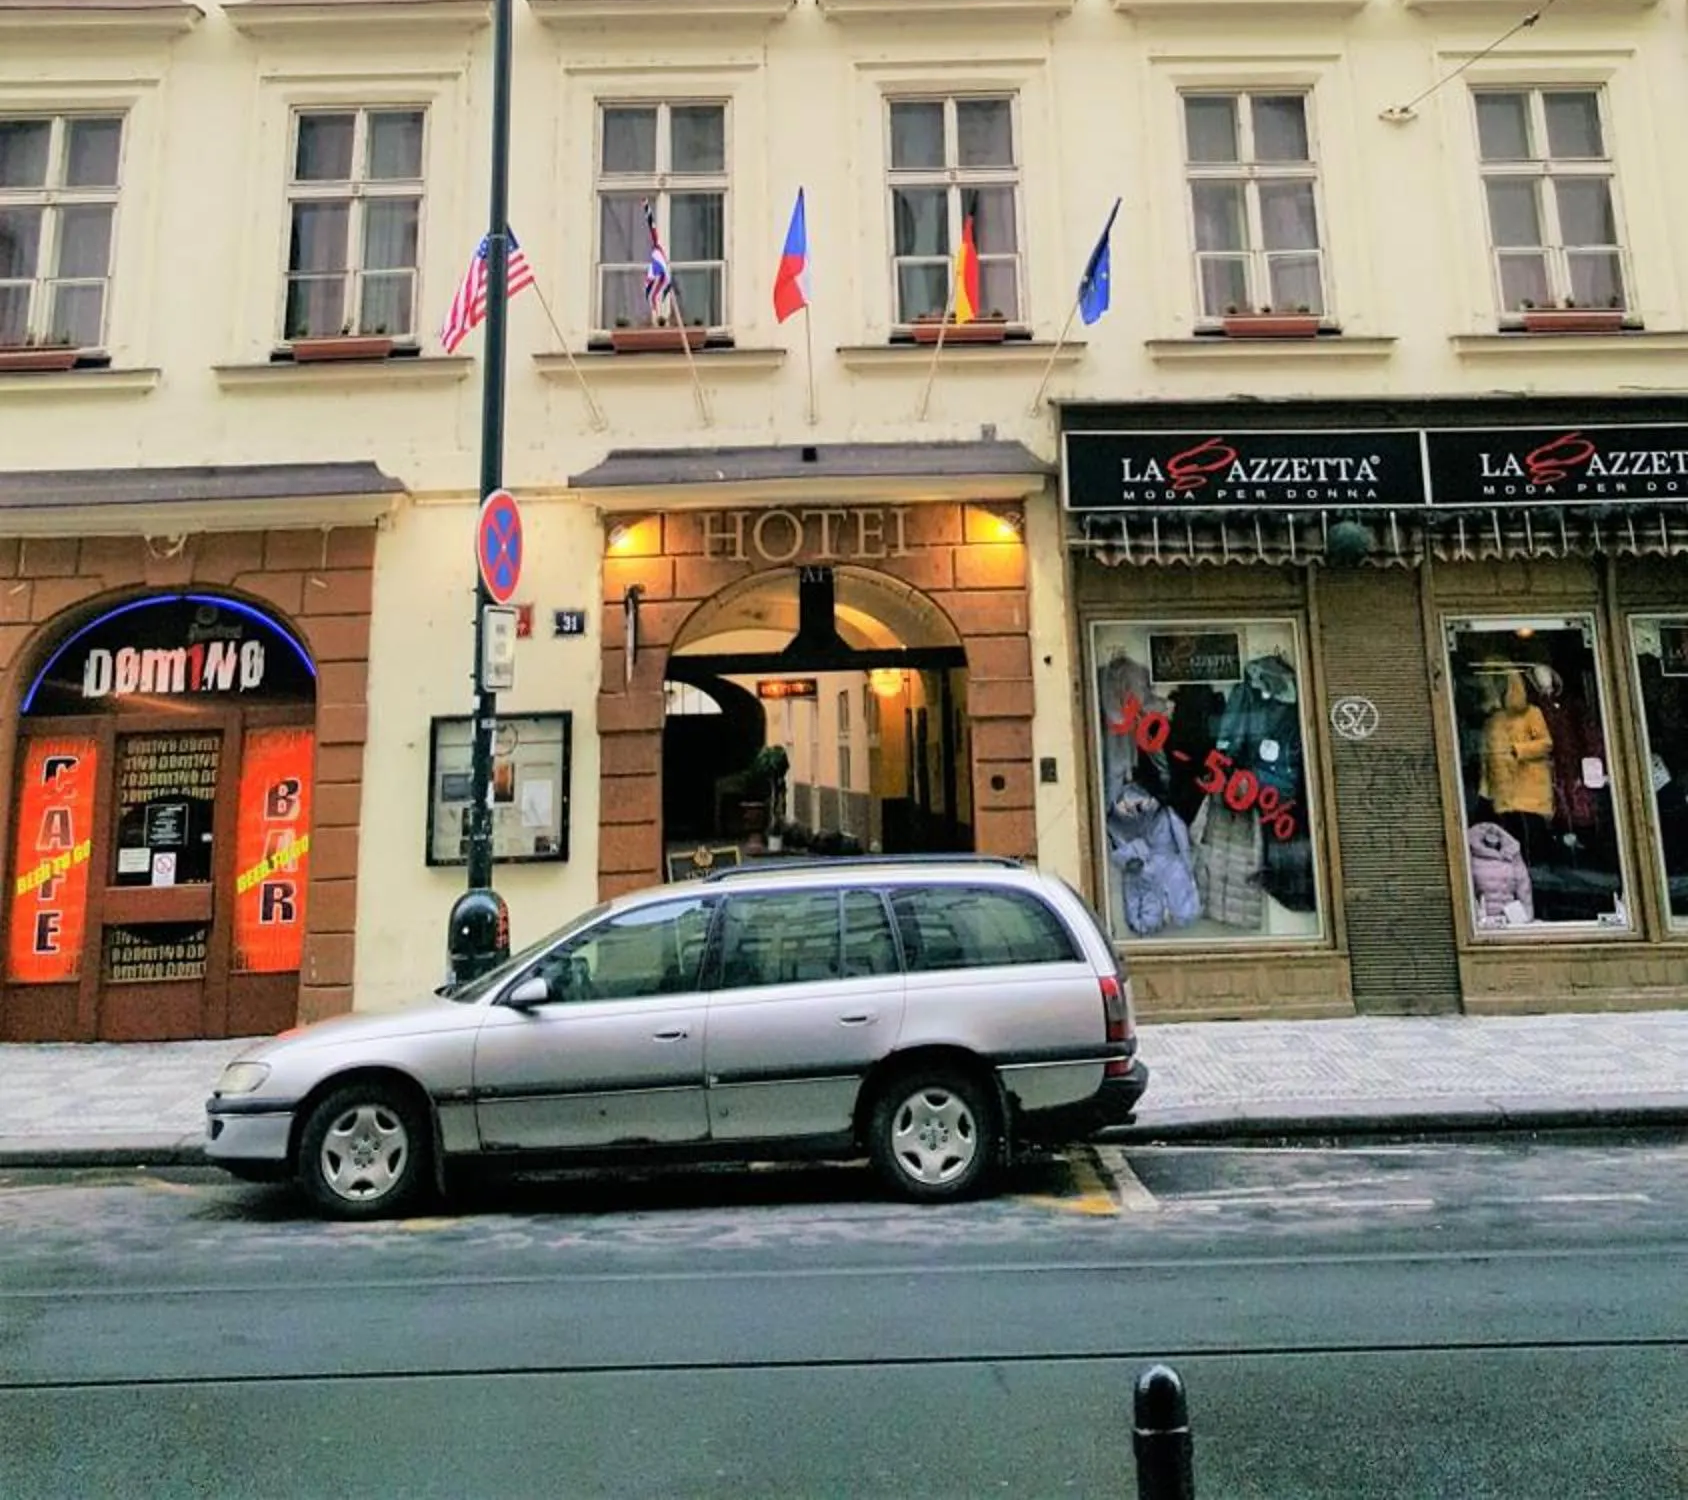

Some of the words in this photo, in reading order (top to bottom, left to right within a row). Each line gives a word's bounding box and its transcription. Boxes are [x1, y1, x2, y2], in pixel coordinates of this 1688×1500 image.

[1121, 458, 1165, 483] LA
[1478, 453, 1525, 477] LA
[1123, 490, 1196, 500] MODA
[1217, 490, 1267, 499] PER
[1287, 488, 1377, 499] DONNA
[1483, 484, 1556, 495] MODA
[1577, 483, 1627, 493] PER
[699, 507, 926, 562] HOTEL
[563, 615, 578, 631] 31
[1195, 749, 1297, 840] 50%
[258, 776, 302, 925] BAR
